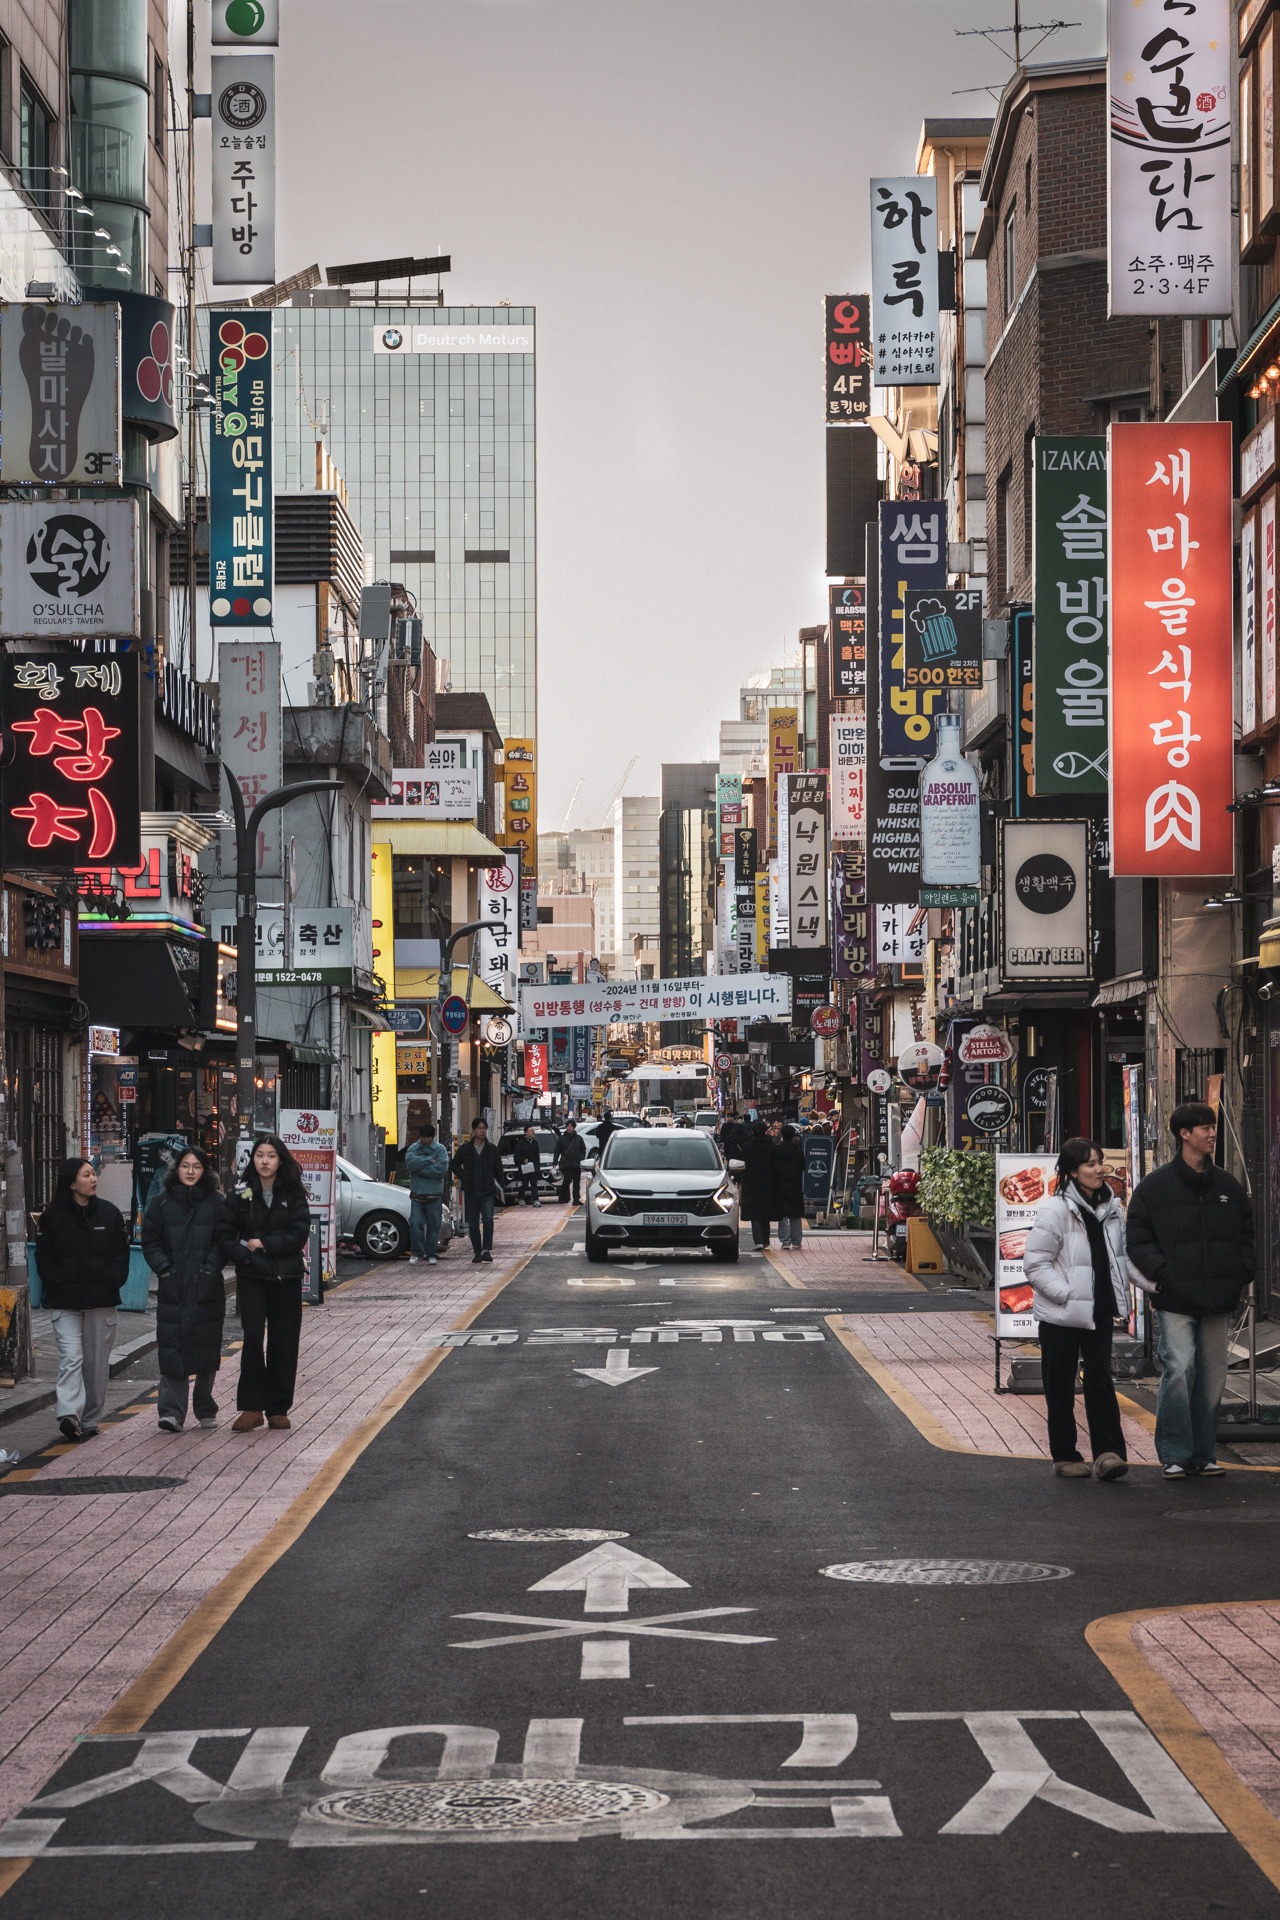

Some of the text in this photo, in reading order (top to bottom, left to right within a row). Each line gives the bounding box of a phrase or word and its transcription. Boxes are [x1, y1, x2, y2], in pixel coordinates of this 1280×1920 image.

[220, 134, 266, 150] 오늘술집
[231, 161, 258, 255] 주다방
[876, 187, 933, 318] 하루
[417, 333, 529, 346] Deutsch Motors
[891, 331, 935, 343] 이자카야
[891, 346, 935, 359] 심야식당
[891, 363, 935, 375] 야키토리
[833, 375, 863, 395] 4F
[39, 341, 69, 475] 발마사지
[829, 400, 868, 415] 토킹바
[84, 452, 114, 475] 3F
[232, 380, 265, 587] 마이큐 당구클럽
[215, 559, 227, 590] 건대점
[955, 592, 980, 611] 2F
[1143, 447, 1202, 769] 새마을식당
[33, 603, 105, 616] O'SULCHA
[1055, 493, 1108, 727] 솔방울
[33, 617, 105, 625] REGULAR'S TAVERN
[840, 620, 865, 634] 맥주
[841, 646, 866, 660] 홀덤
[13, 661, 122, 701] 황제
[841, 670, 866, 685] 만원
[907, 667, 981, 685] 500 한잔
[848, 687, 860, 695] 2F
[838, 743, 865, 756] 이하
[428, 749, 456, 764] 심야
[11, 707, 122, 859] 참치
[795, 777, 819, 789] 피맥
[928, 782, 972, 794] ABSOLUT
[790, 790, 825, 803] 전문점
[887, 788, 919, 799] SOJU
[923, 793, 977, 806] GRAPEFRUIT
[887, 803, 918, 814] BEER
[887, 862, 920, 874] WINE
[795, 820, 820, 940] 낙원스낵
[1017, 875, 1075, 895] 생활맥주
[299, 923, 343, 946] 축산
[1008, 947, 1085, 966] CRAFT BEER
[275, 972, 323, 982] 1522-0478
[640, 983, 660, 994] 11월
[533, 987, 780, 1017] 일방통행 (성수동 건대 방향) 이 시행됩니다.
[816, 1017, 840, 1028] 노래방
[863, 995, 882, 1058] 노래방
[970, 1041, 1001, 1049] STELLA
[970, 1048, 1001, 1056] ARTOIS
[718, 1058, 729, 1067] 30
[120, 1072, 135, 1080] ADT
[575, 1070, 586, 1079] B1
[975, 1089, 1003, 1100] GOOSE
[976, 1114, 1006, 1127] ISLAND
[282, 1134, 334, 1146] 코인 노래연습장
[666, 1216, 685, 1224] 1092
[1002, 1265, 1025, 1273] 한돈생
[1012, 1319, 1032, 1327] 껍데기
[0, 1710, 1229, 1858] 진입금지
